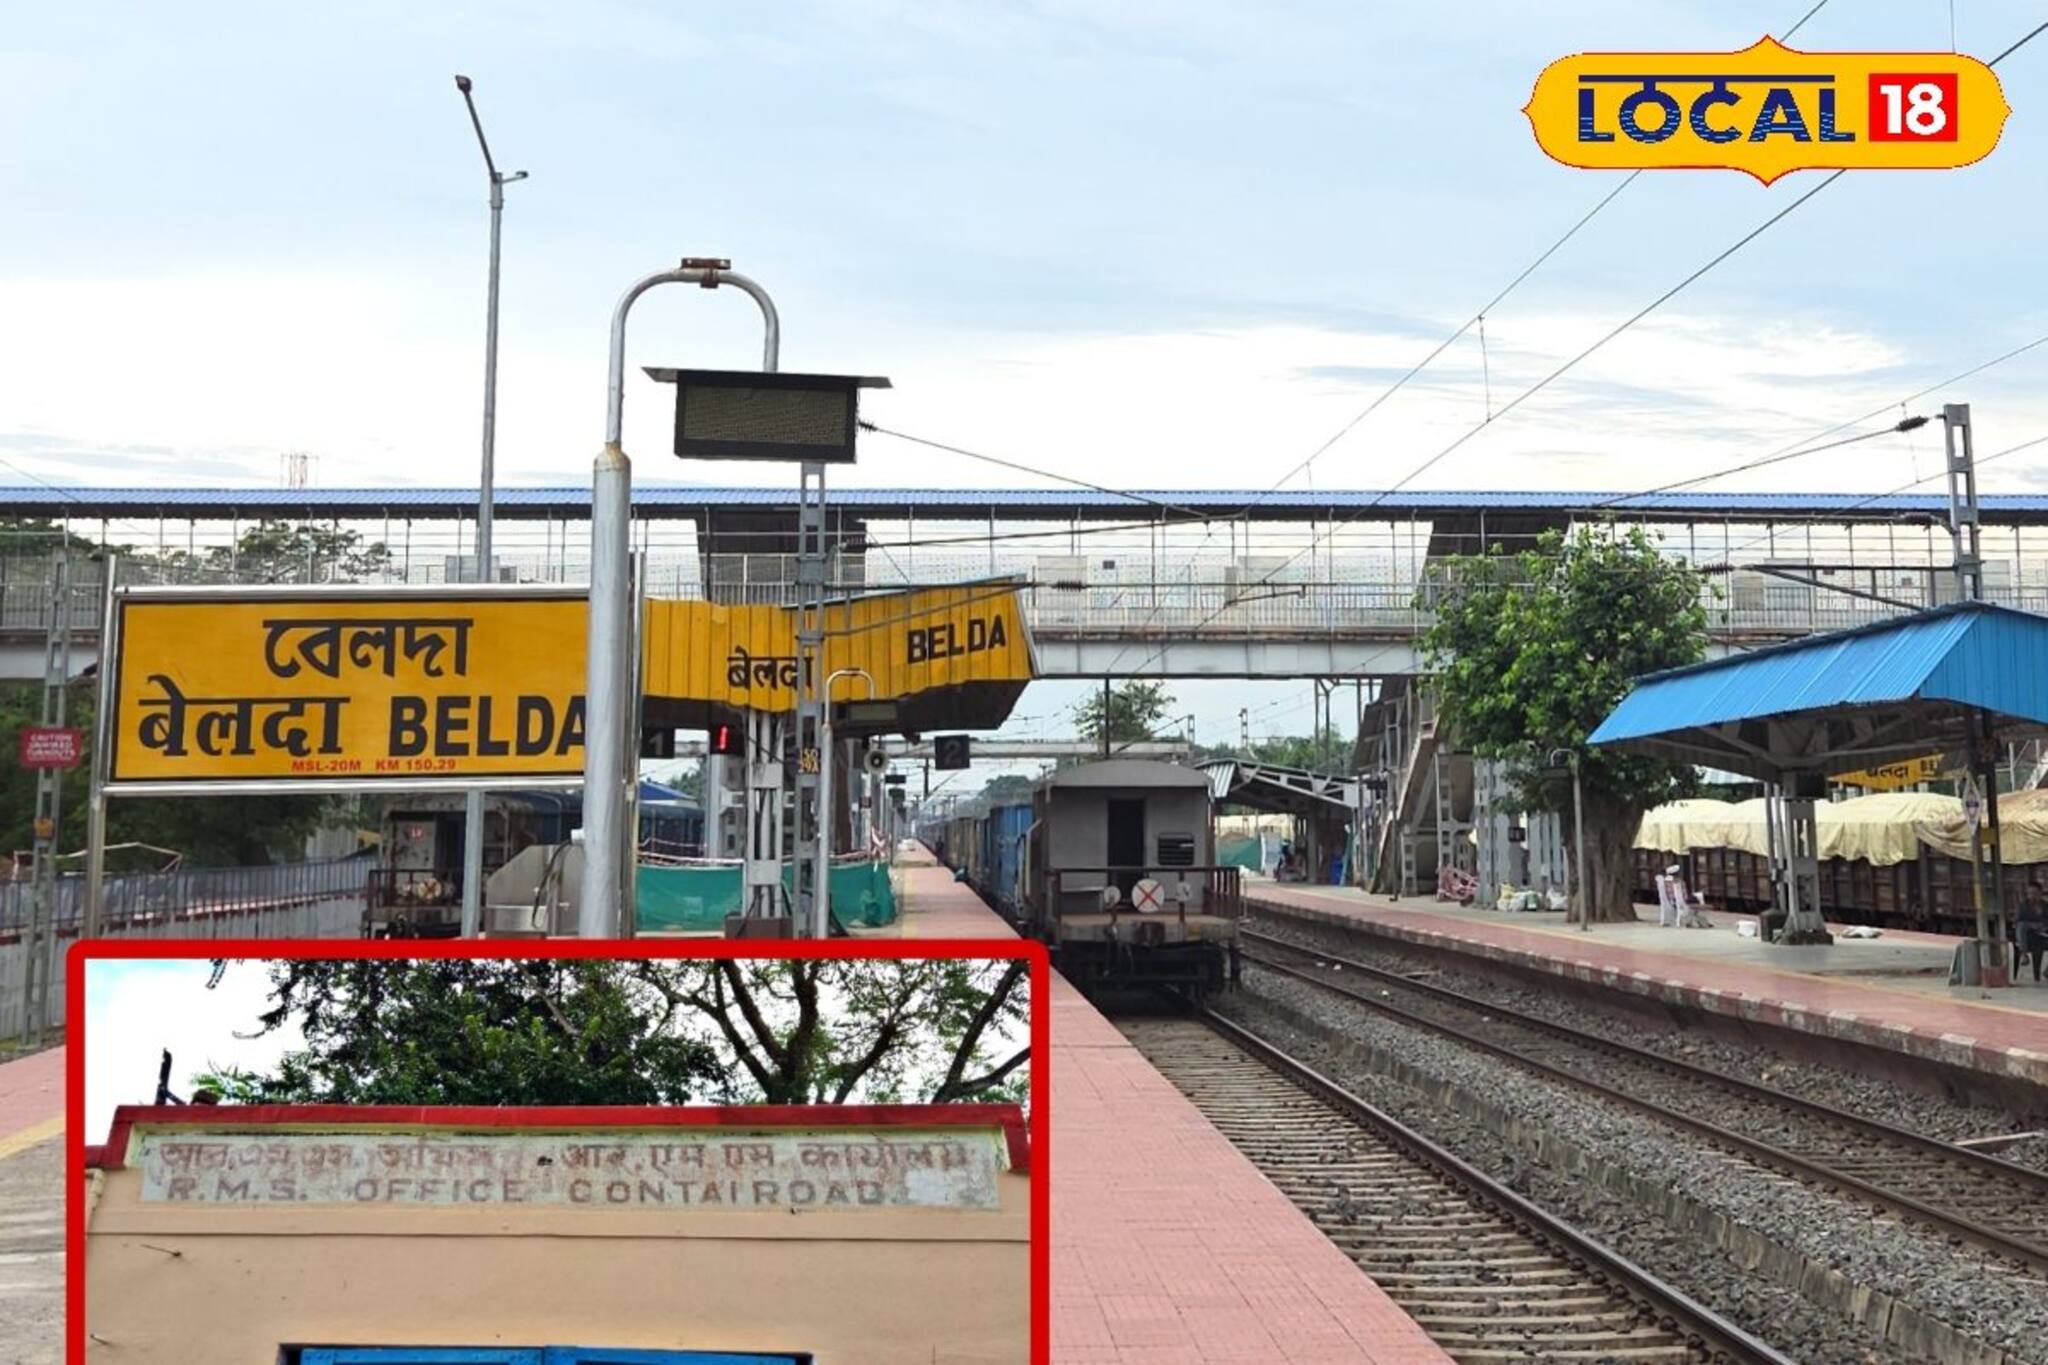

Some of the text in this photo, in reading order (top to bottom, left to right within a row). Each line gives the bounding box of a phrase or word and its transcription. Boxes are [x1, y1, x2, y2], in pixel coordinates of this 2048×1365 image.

[262, 618, 473, 677] বেলদা
[906, 614, 1006, 664] BELDA
[138, 674, 350, 756] बेलदा
[388, 695, 586, 756] BELDA
[292, 759, 456, 771] MSL-20M KM 150.29
[354, 1177, 524, 1202] OFFICE
